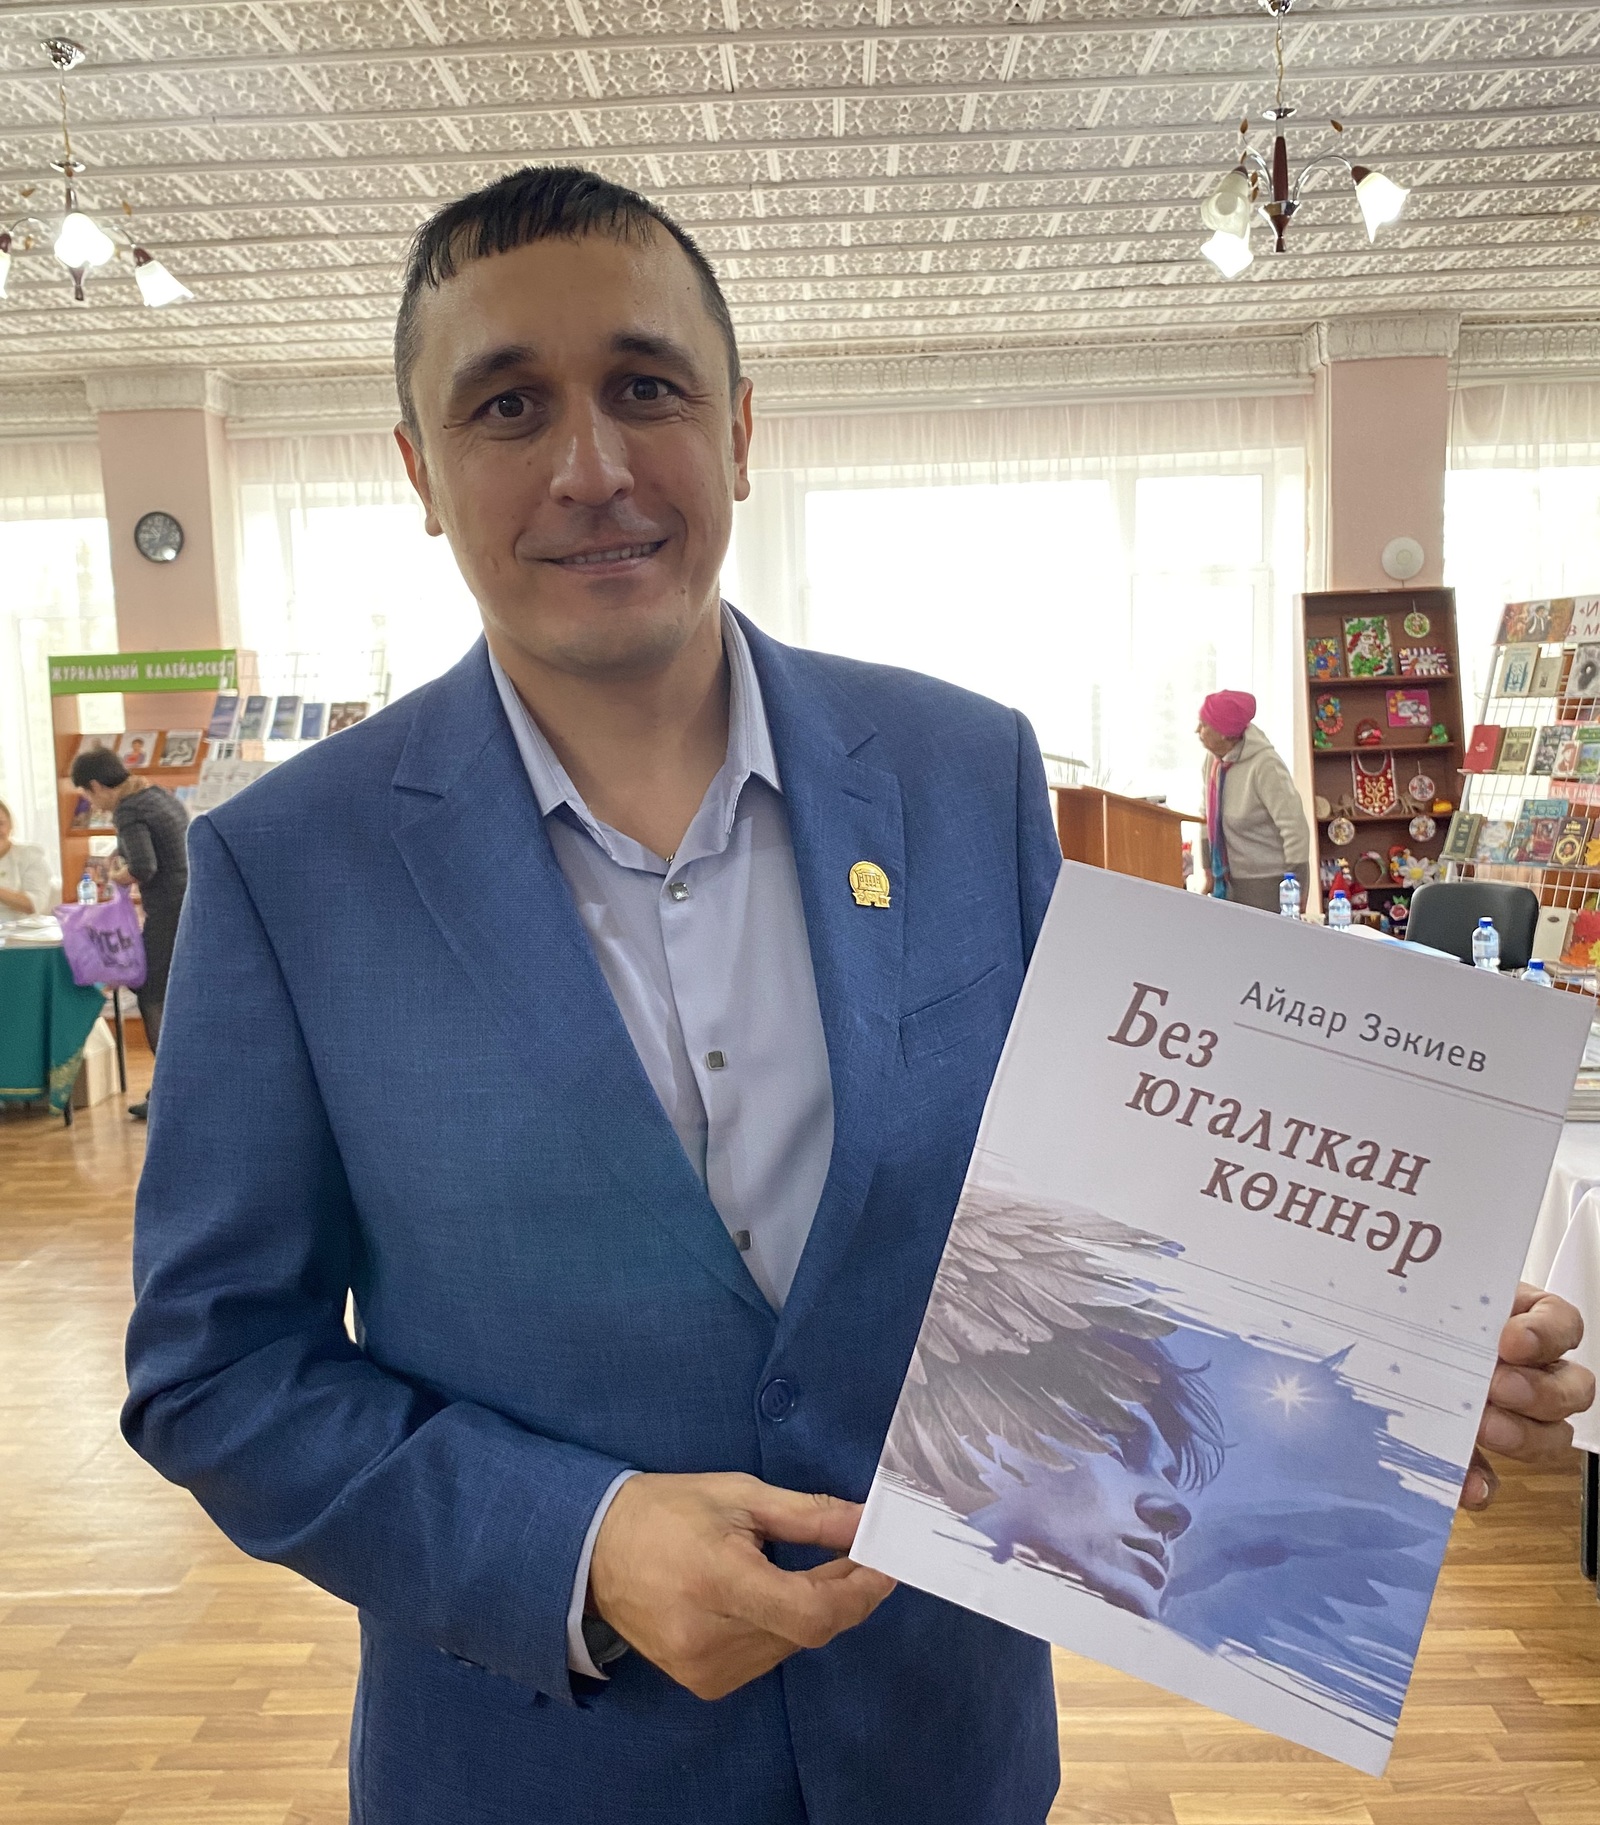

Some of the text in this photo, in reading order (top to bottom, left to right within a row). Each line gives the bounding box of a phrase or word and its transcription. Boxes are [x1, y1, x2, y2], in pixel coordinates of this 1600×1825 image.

[52, 660, 139, 681] ЖУРНАЛЬНЫЙ
[1106, 981, 1219, 1068] Без
[1240, 980, 1487, 1073] Айдар Зәкиев
[1124, 1071, 1432, 1197] югалткан
[1199, 1157, 1443, 1279] көннәр
